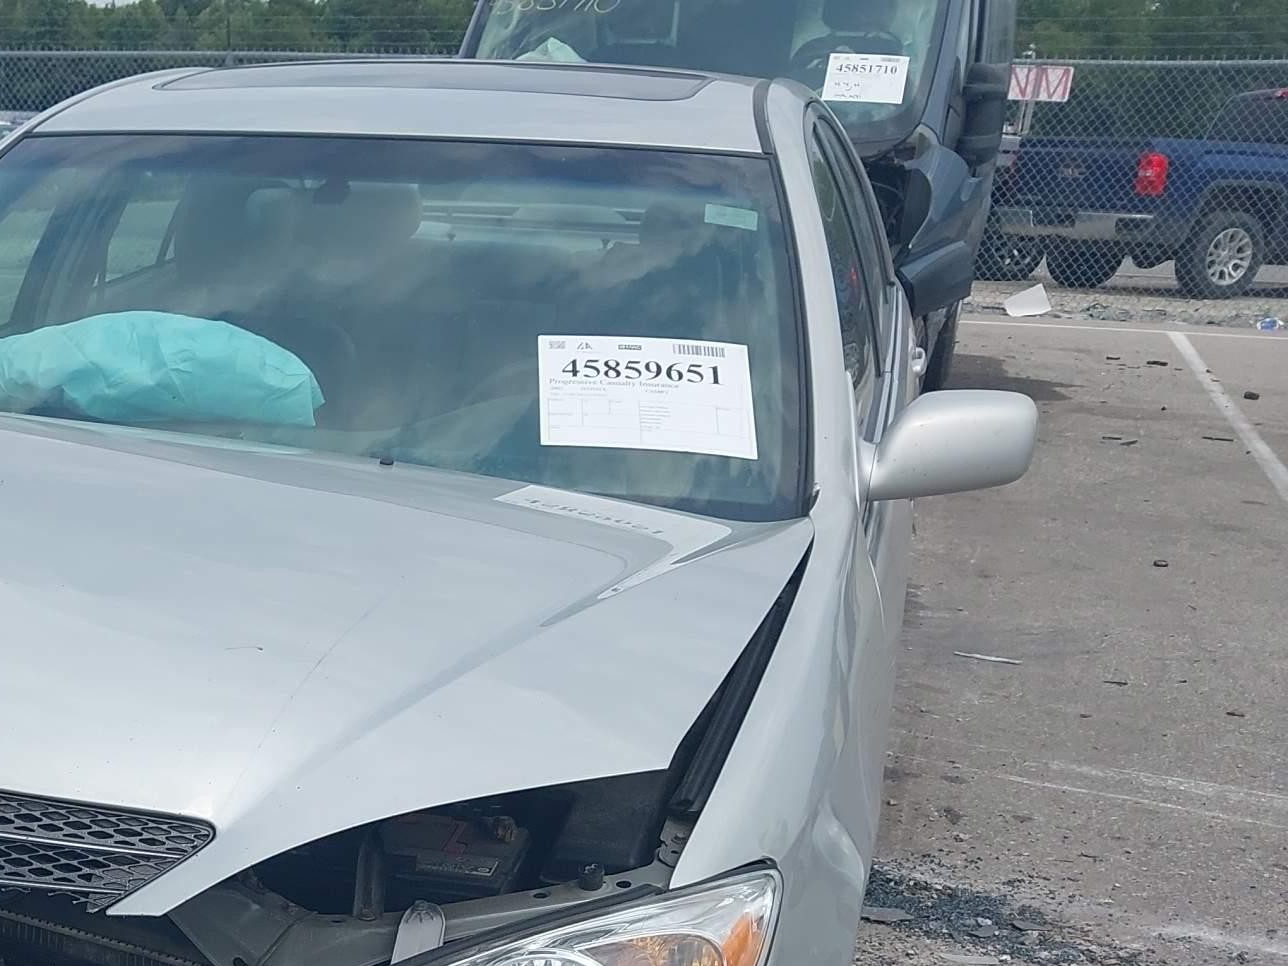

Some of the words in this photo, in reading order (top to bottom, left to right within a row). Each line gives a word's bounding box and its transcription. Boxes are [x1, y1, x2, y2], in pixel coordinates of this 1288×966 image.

[835, 63, 899, 75] 45851710
[561, 358, 724, 386] 45859651
[549, 377, 599, 387] Progressive
[599, 379, 636, 388] Casualty
[639, 380, 680, 389] Insurance
